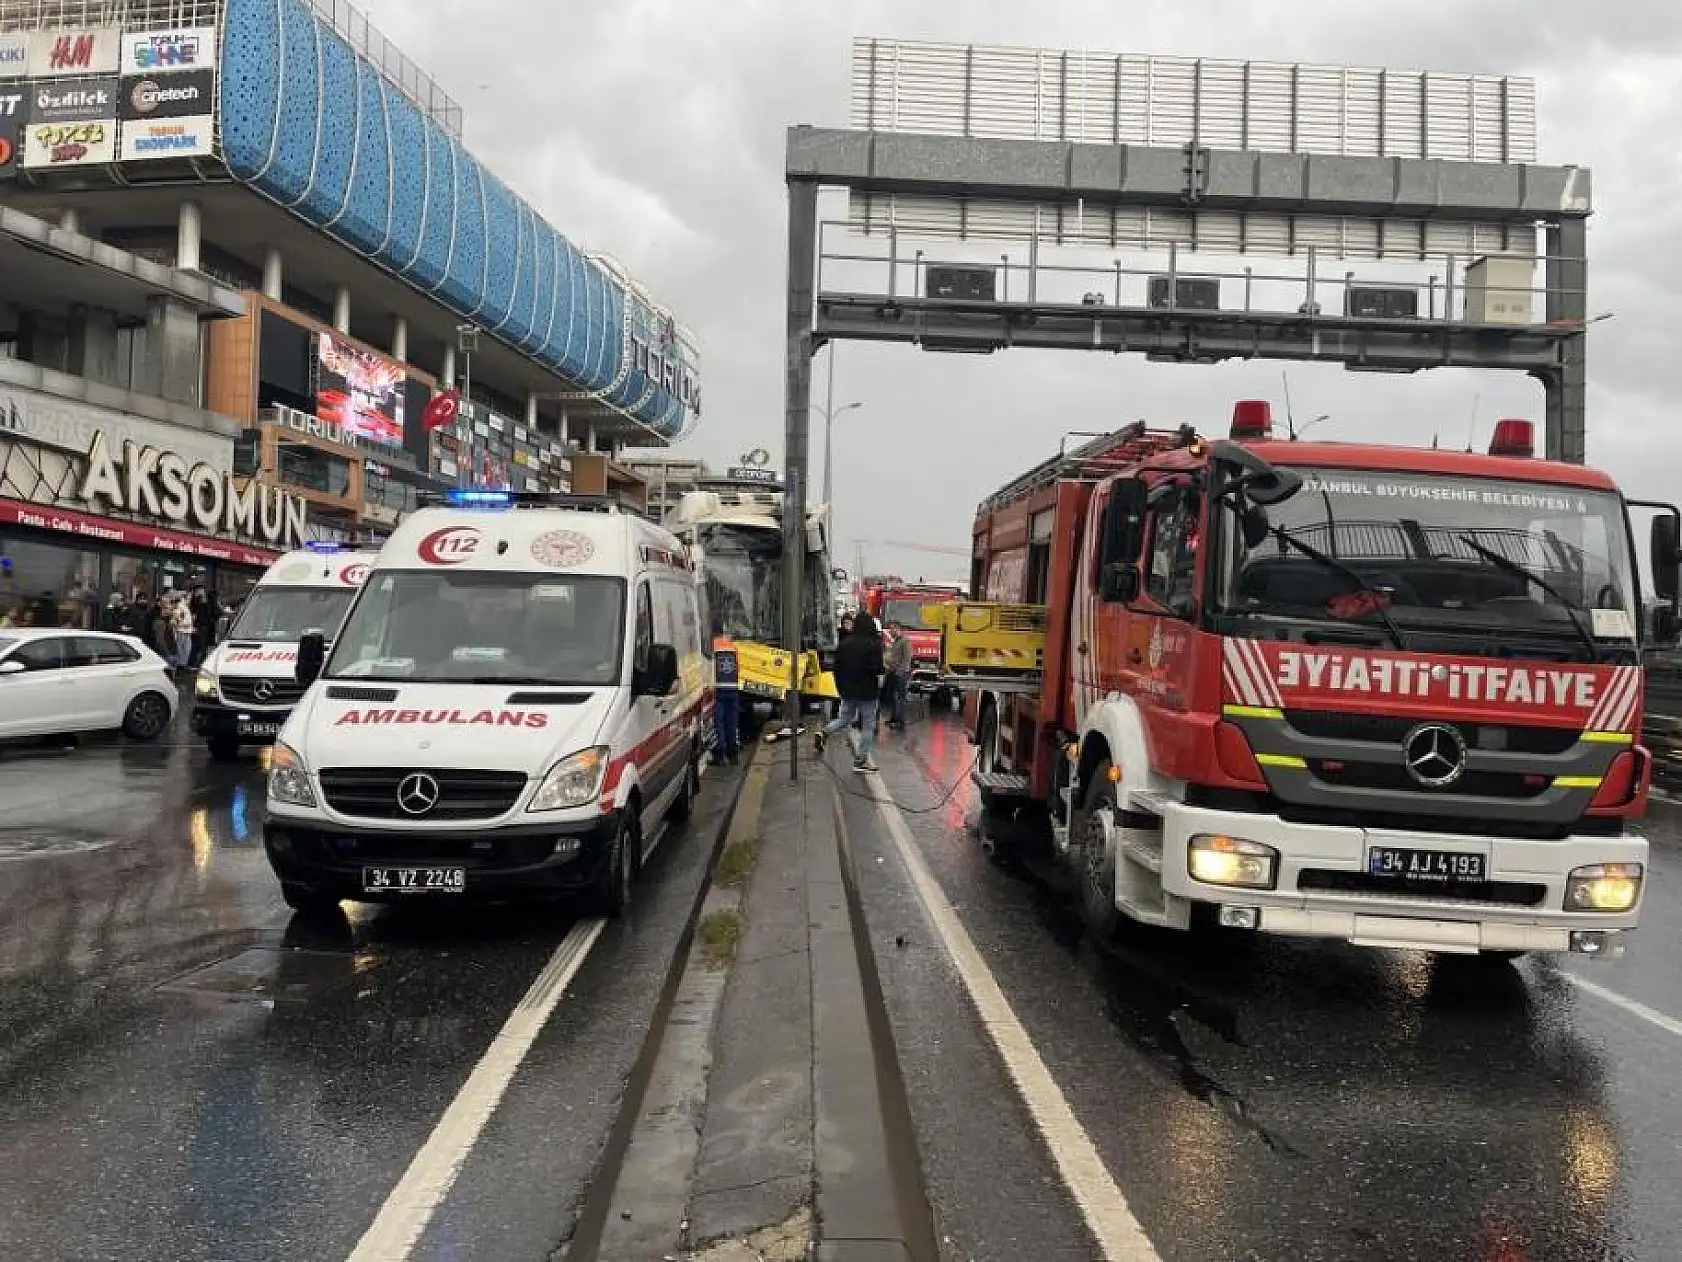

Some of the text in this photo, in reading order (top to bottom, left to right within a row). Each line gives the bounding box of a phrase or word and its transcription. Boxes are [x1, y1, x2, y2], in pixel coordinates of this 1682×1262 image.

[272, 401, 358, 449] TORIUM
[80, 429, 308, 551] AKSOMUN
[438, 537, 480, 553] 112
[335, 709, 548, 728] AMBULANS
[1383, 851, 1481, 875] 34 AJ 4193
[373, 869, 391, 886] 34
[399, 869, 417, 886] VZ
